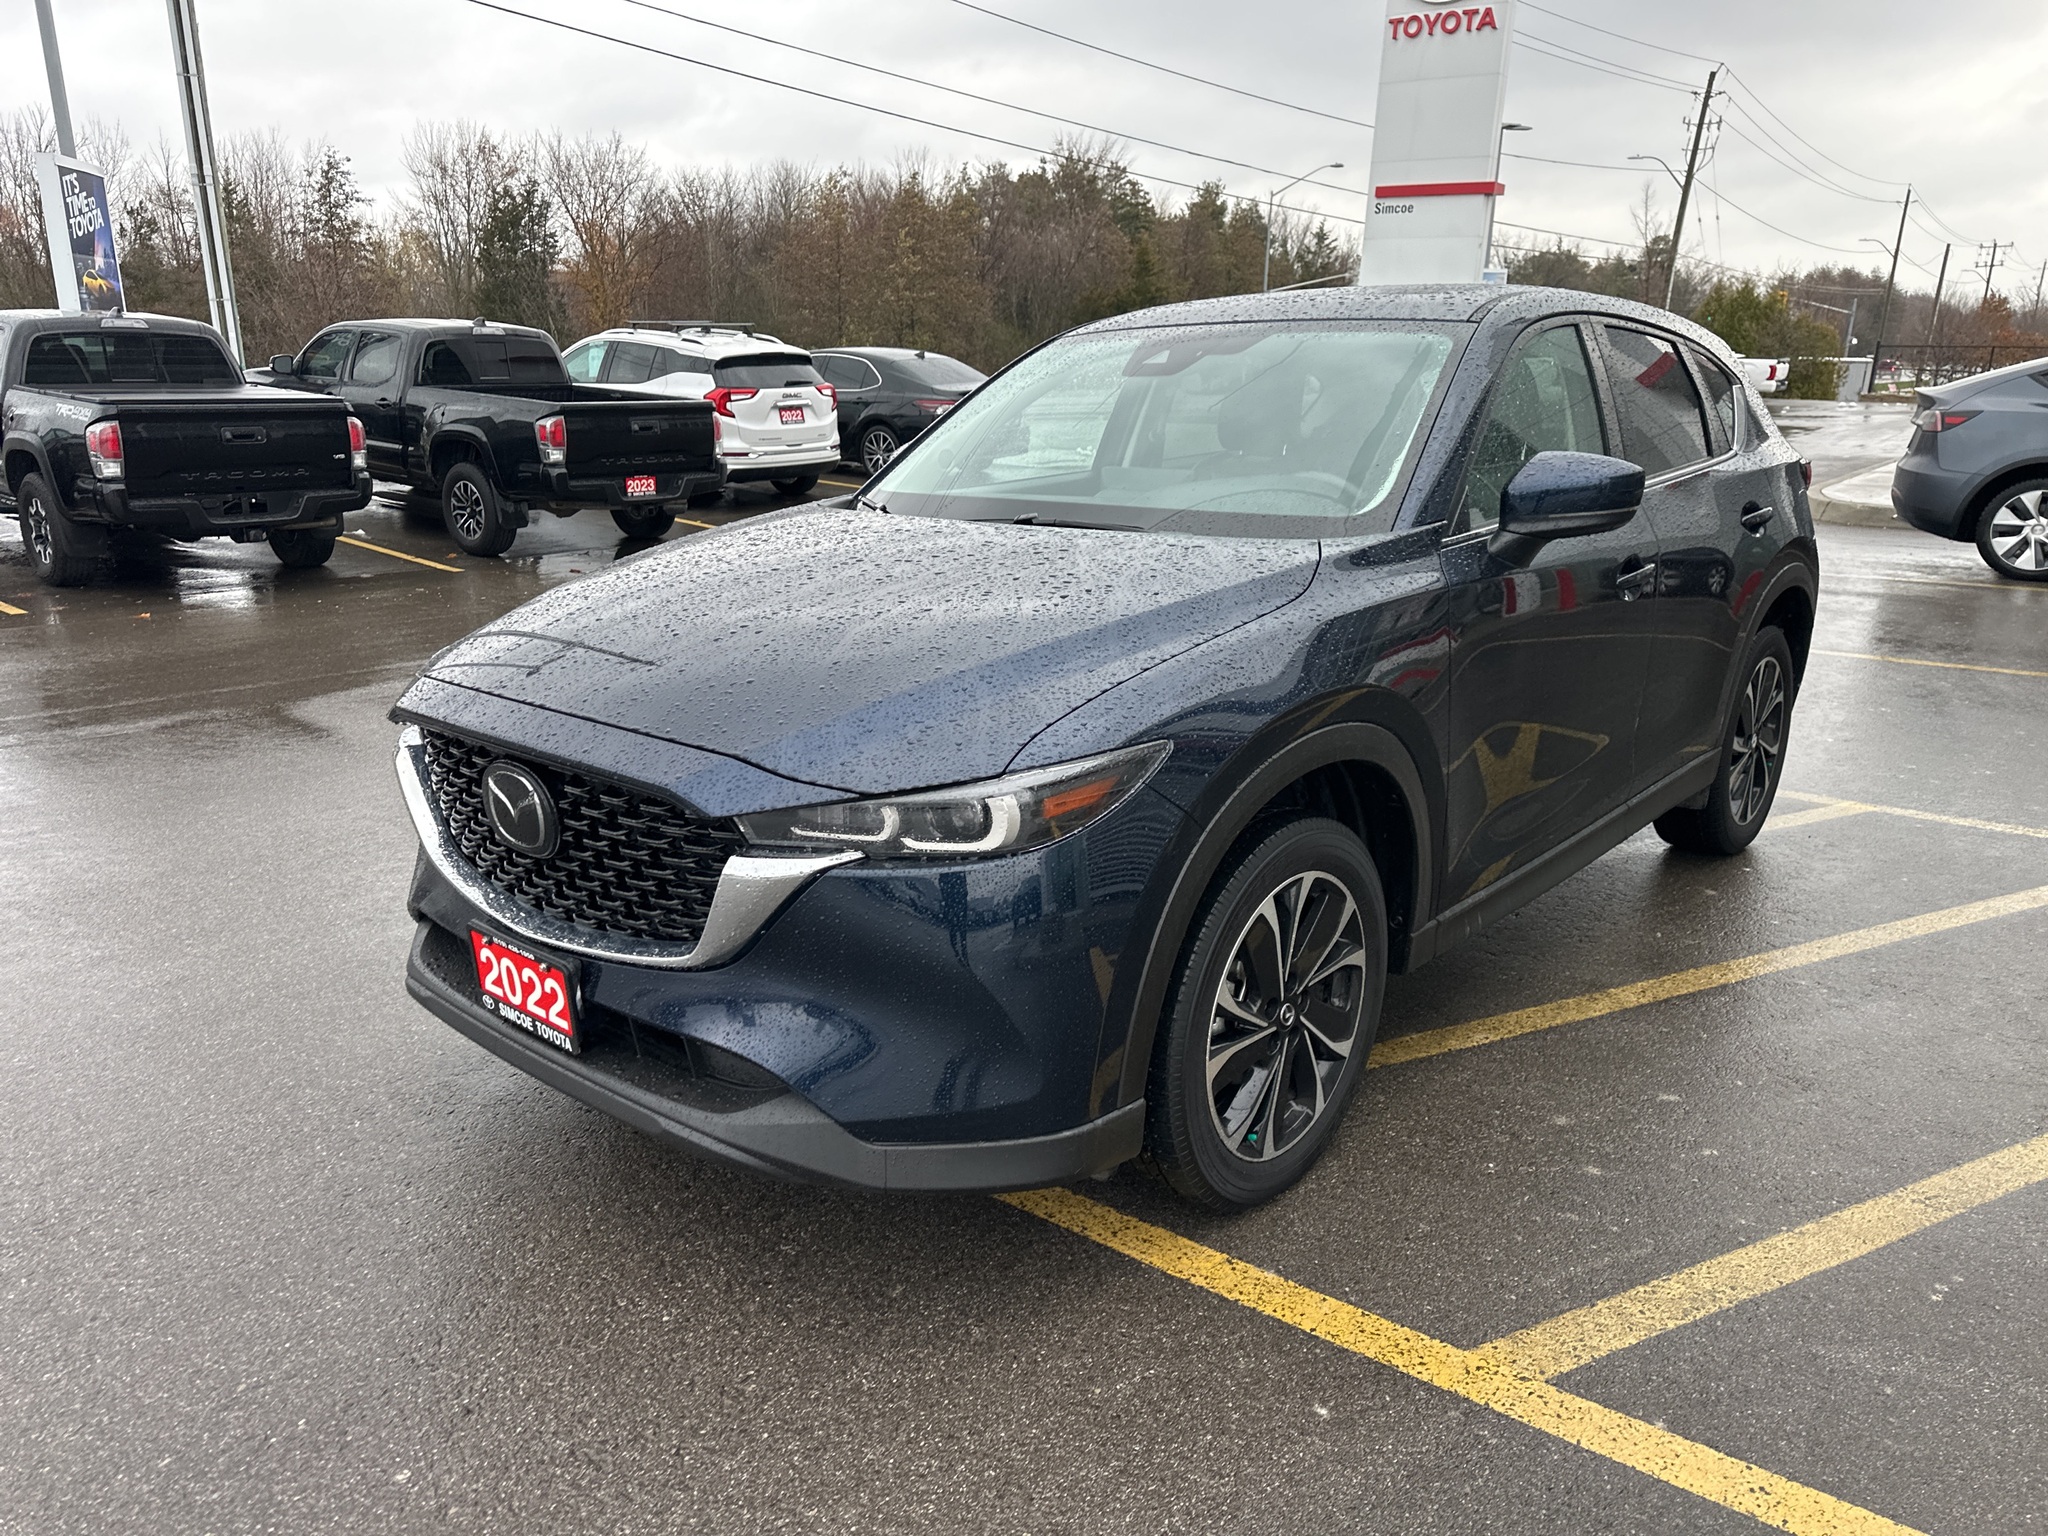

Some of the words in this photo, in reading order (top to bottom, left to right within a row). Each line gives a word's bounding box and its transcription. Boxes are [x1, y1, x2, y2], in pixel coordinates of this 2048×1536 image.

[1389, 6, 1497, 40] TOYOTA
[62, 172, 80, 197] IT'S
[66, 191, 89, 217] TIME
[87, 196, 96, 210] TO
[1374, 202, 1414, 215] Simcoe
[69, 207, 104, 239] TOYOTA
[781, 409, 803, 421] 2022
[601, 454, 686, 466] TACOMA
[180, 468, 310, 481] TACOMA
[627, 478, 655, 492] 2023
[480, 947, 569, 1031] 2022
[498, 1002, 534, 1032] SIMCOE
[535, 1021, 573, 1052] TOYOTA
